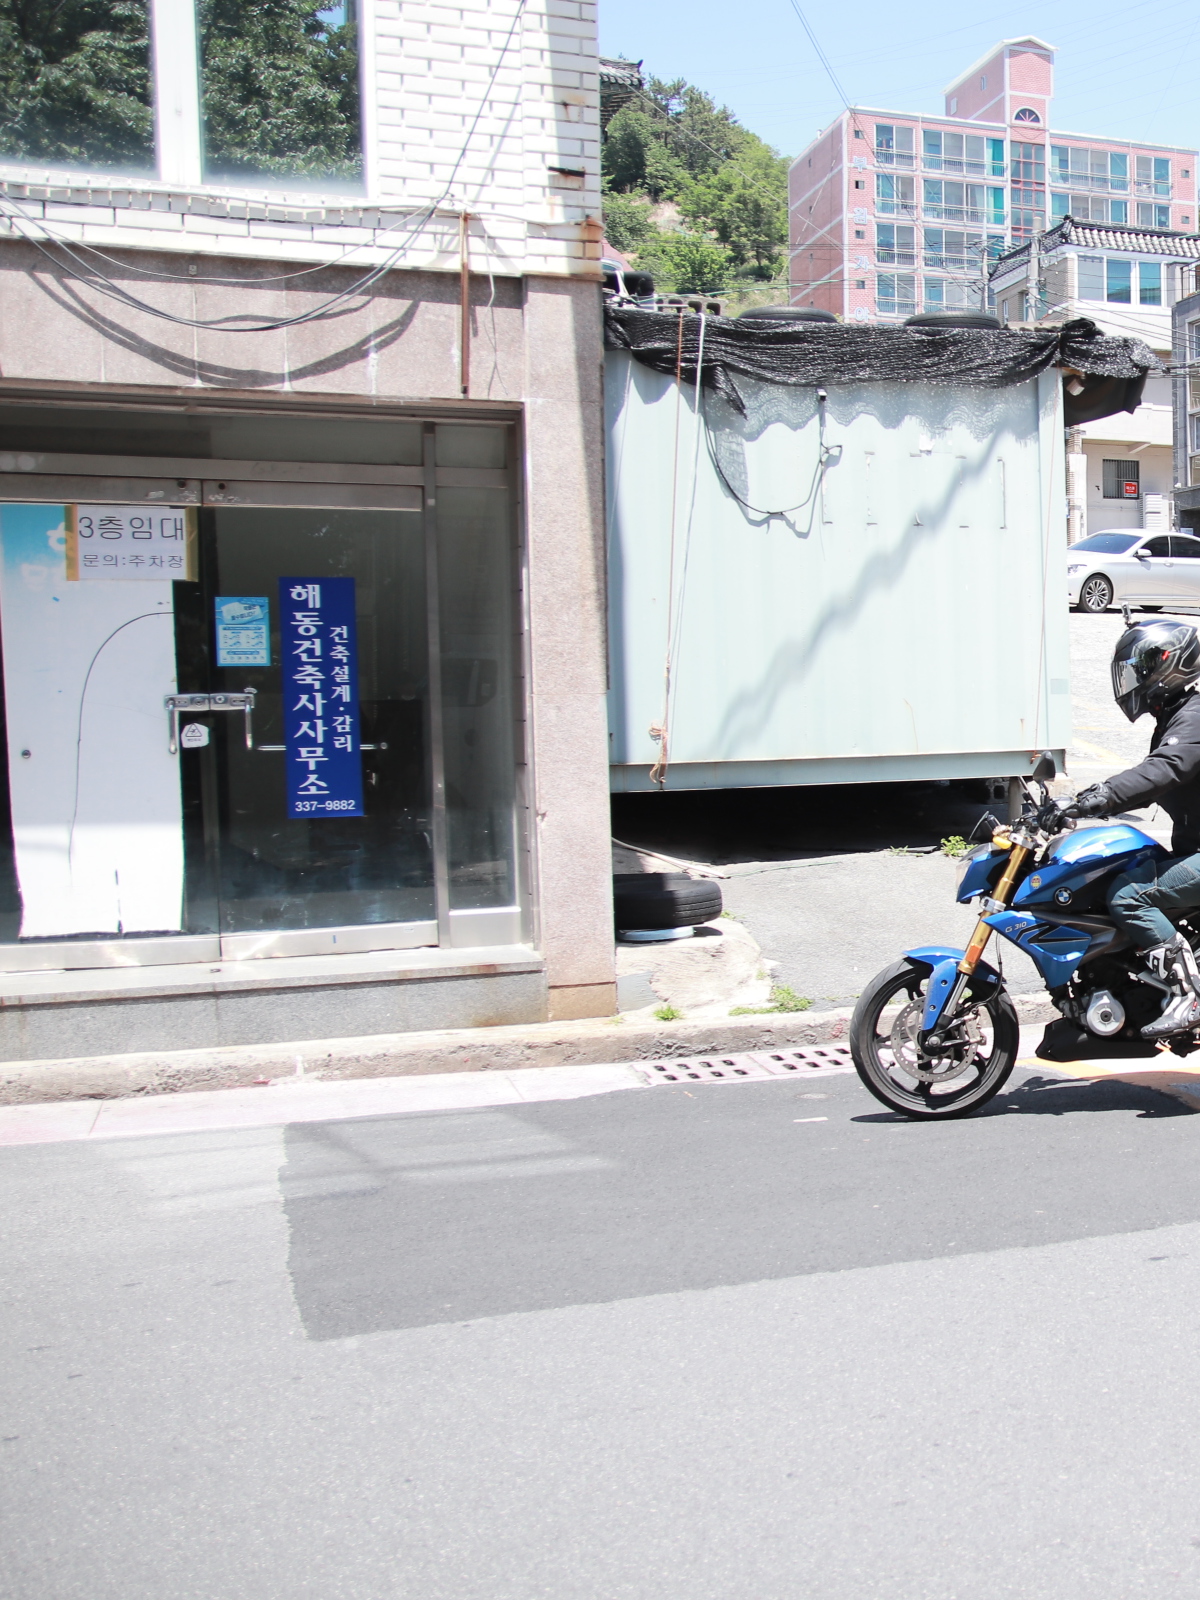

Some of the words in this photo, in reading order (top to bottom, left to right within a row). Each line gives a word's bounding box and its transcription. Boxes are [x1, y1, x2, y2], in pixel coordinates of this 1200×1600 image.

[289, 584, 330, 794] 해동건축사사무소
[295, 800, 356, 812] 337-9882
[1014, 921, 1027, 931] 310
